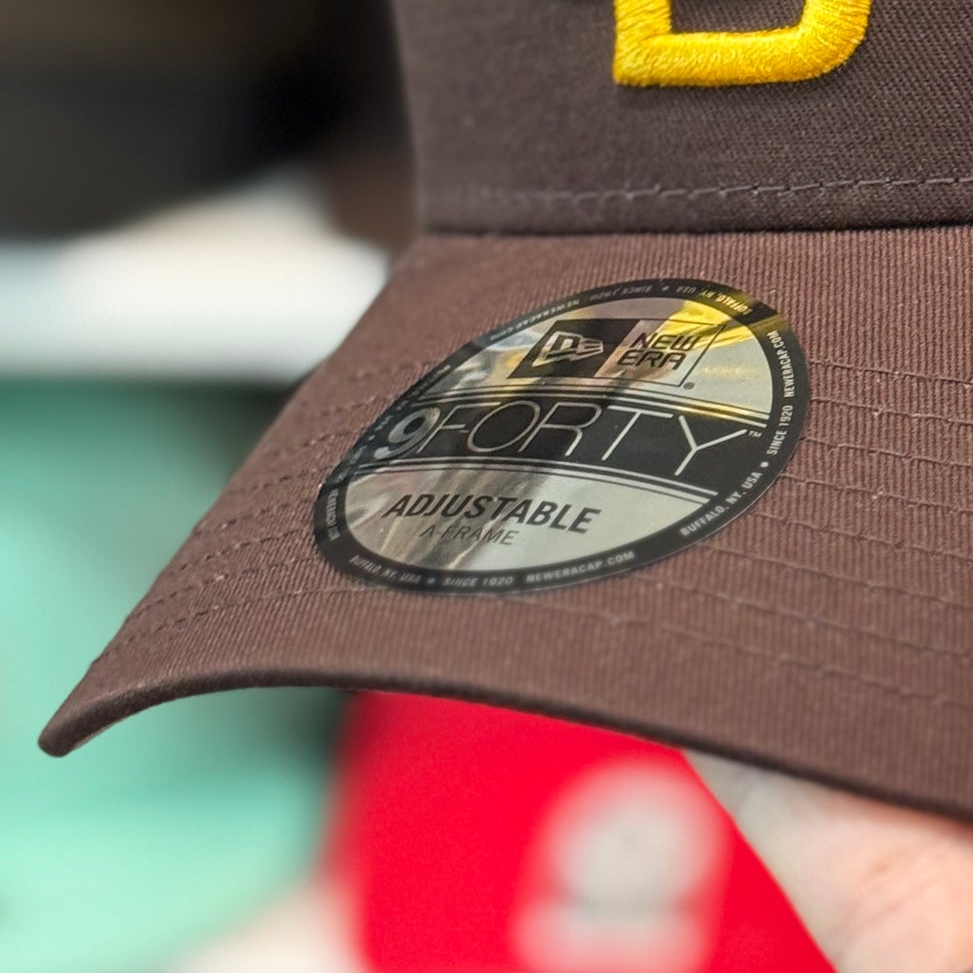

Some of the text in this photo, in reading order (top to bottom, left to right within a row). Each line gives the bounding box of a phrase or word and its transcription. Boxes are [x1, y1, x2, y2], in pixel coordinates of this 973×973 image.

[629, 332, 700, 353] NEW
[617, 351, 688, 371] ERA
[766, 329, 796, 398] NEWERACAP.COM
[778, 404, 794, 427] 1920
[766, 429, 788, 456] SINCE
[741, 471, 763, 490] USA
[381, 493, 602, 534] ADJUSTABLE
[418, 524, 520, 547] A-FRAME
[442, 575, 477, 587] SINCE
[482, 575, 514, 586] 1920
[525, 549, 636, 584] NEWERACAP.COM
